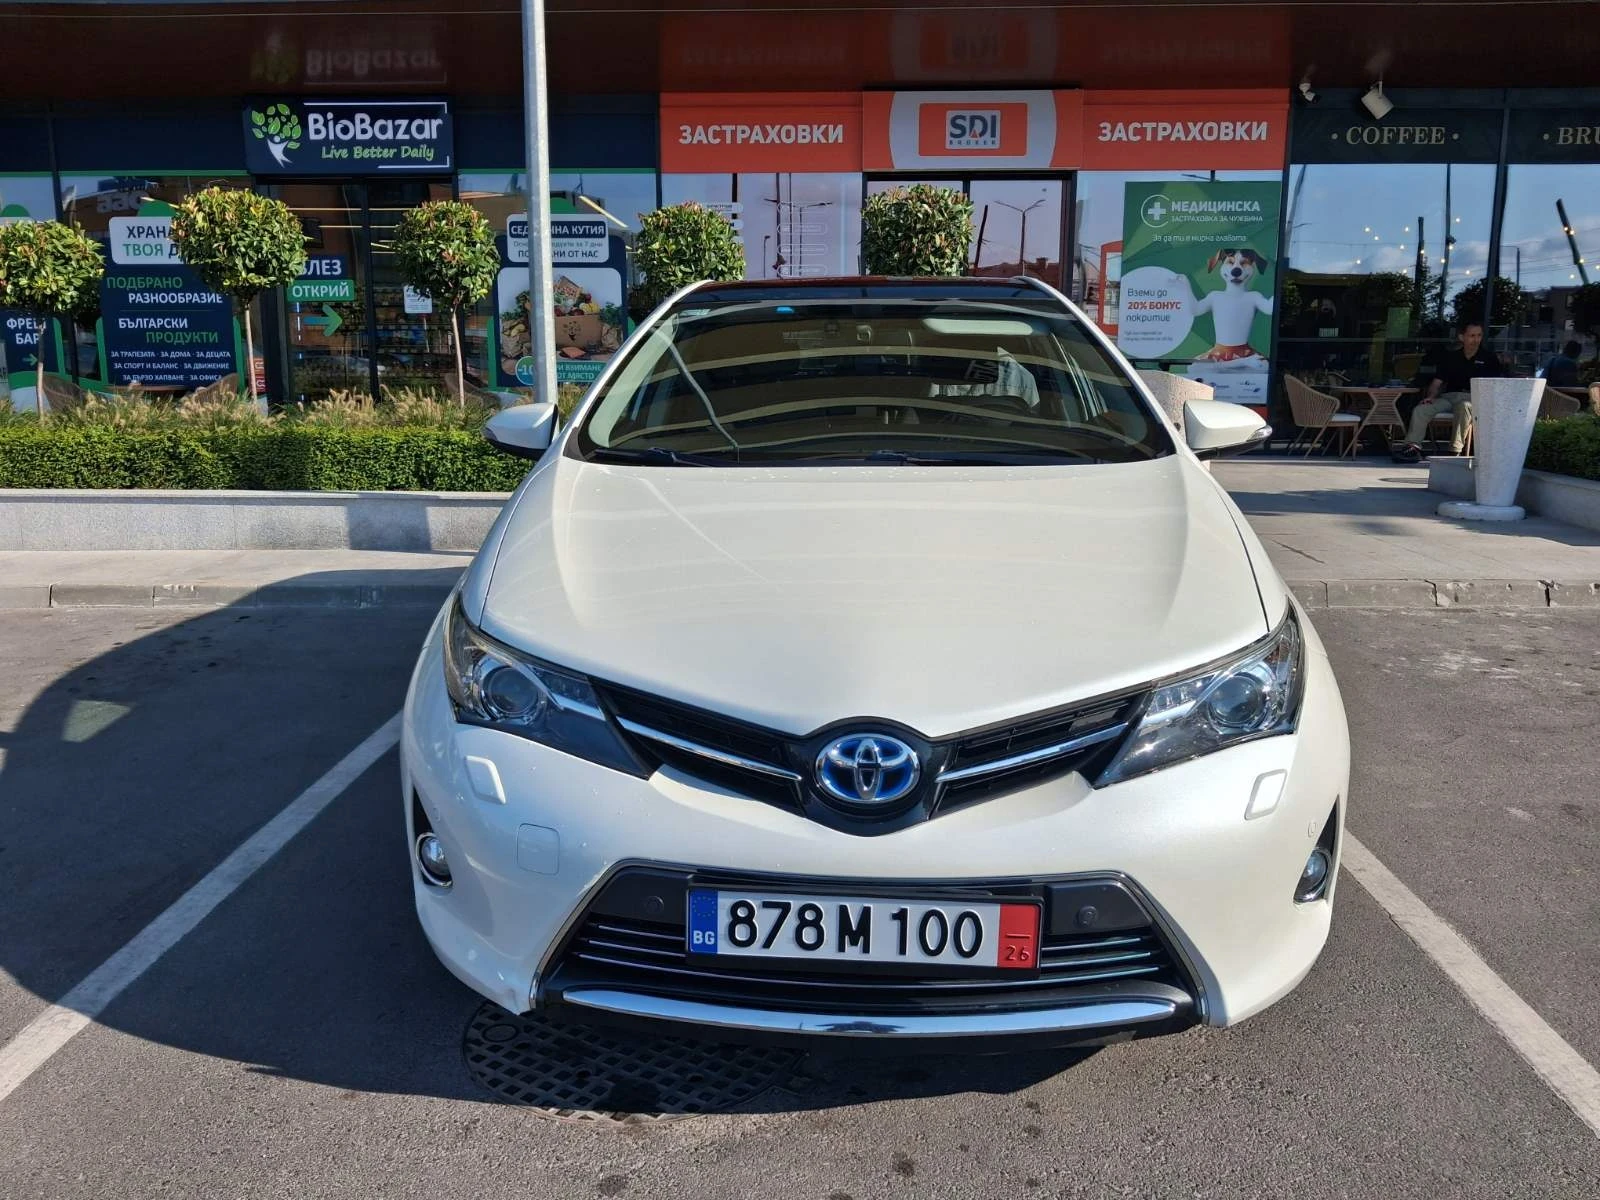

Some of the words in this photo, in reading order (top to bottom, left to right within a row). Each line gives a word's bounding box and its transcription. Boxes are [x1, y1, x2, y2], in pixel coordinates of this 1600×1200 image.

[307, 112, 443, 141] BioBazar
[949, 114, 997, 139] SDI
[1098, 121, 1268, 142] ЗАСТРАХОВКИ
[679, 124, 844, 145] ЗАСТРАХОВКИ
[1345, 126, 1446, 145] COFFEE
[321, 144, 349, 159] Live
[353, 145, 398, 159] Better
[400, 144, 434, 162] Daily
[1171, 200, 1261, 213] МЕДИЦИНСКА
[571, 225, 605, 235] КУТИЯ
[122, 243, 164, 257] ТВОЯ
[567, 250, 579, 258] ОТ
[581, 250, 599, 258] НАС
[106, 277, 183, 291] ПОДБРАНО
[292, 281, 350, 298] ОТКРИЙ
[128, 292, 223, 304] РАЗНООБРАЗИЕ
[1127, 288, 1155, 297] Вземи
[1156, 289, 1168, 298] до
[1127, 301, 1148, 310] 20%
[1149, 301, 1182, 310] БОНУС
[118, 317, 189, 329] БЪЛГАРСКИ
[1126, 313, 1171, 323] покритие
[15, 332, 40, 345] БАР
[146, 331, 219, 346] ПРОДУКТИ
[169, 351, 191, 359] ДОМА
[205, 351, 231, 359] ДЕЦАТА
[728, 899, 825, 952] 878
[837, 904, 872, 955] M
[891, 906, 984, 959] 100
[693, 930, 715, 945] BG
[1005, 944, 1031, 962] 26
